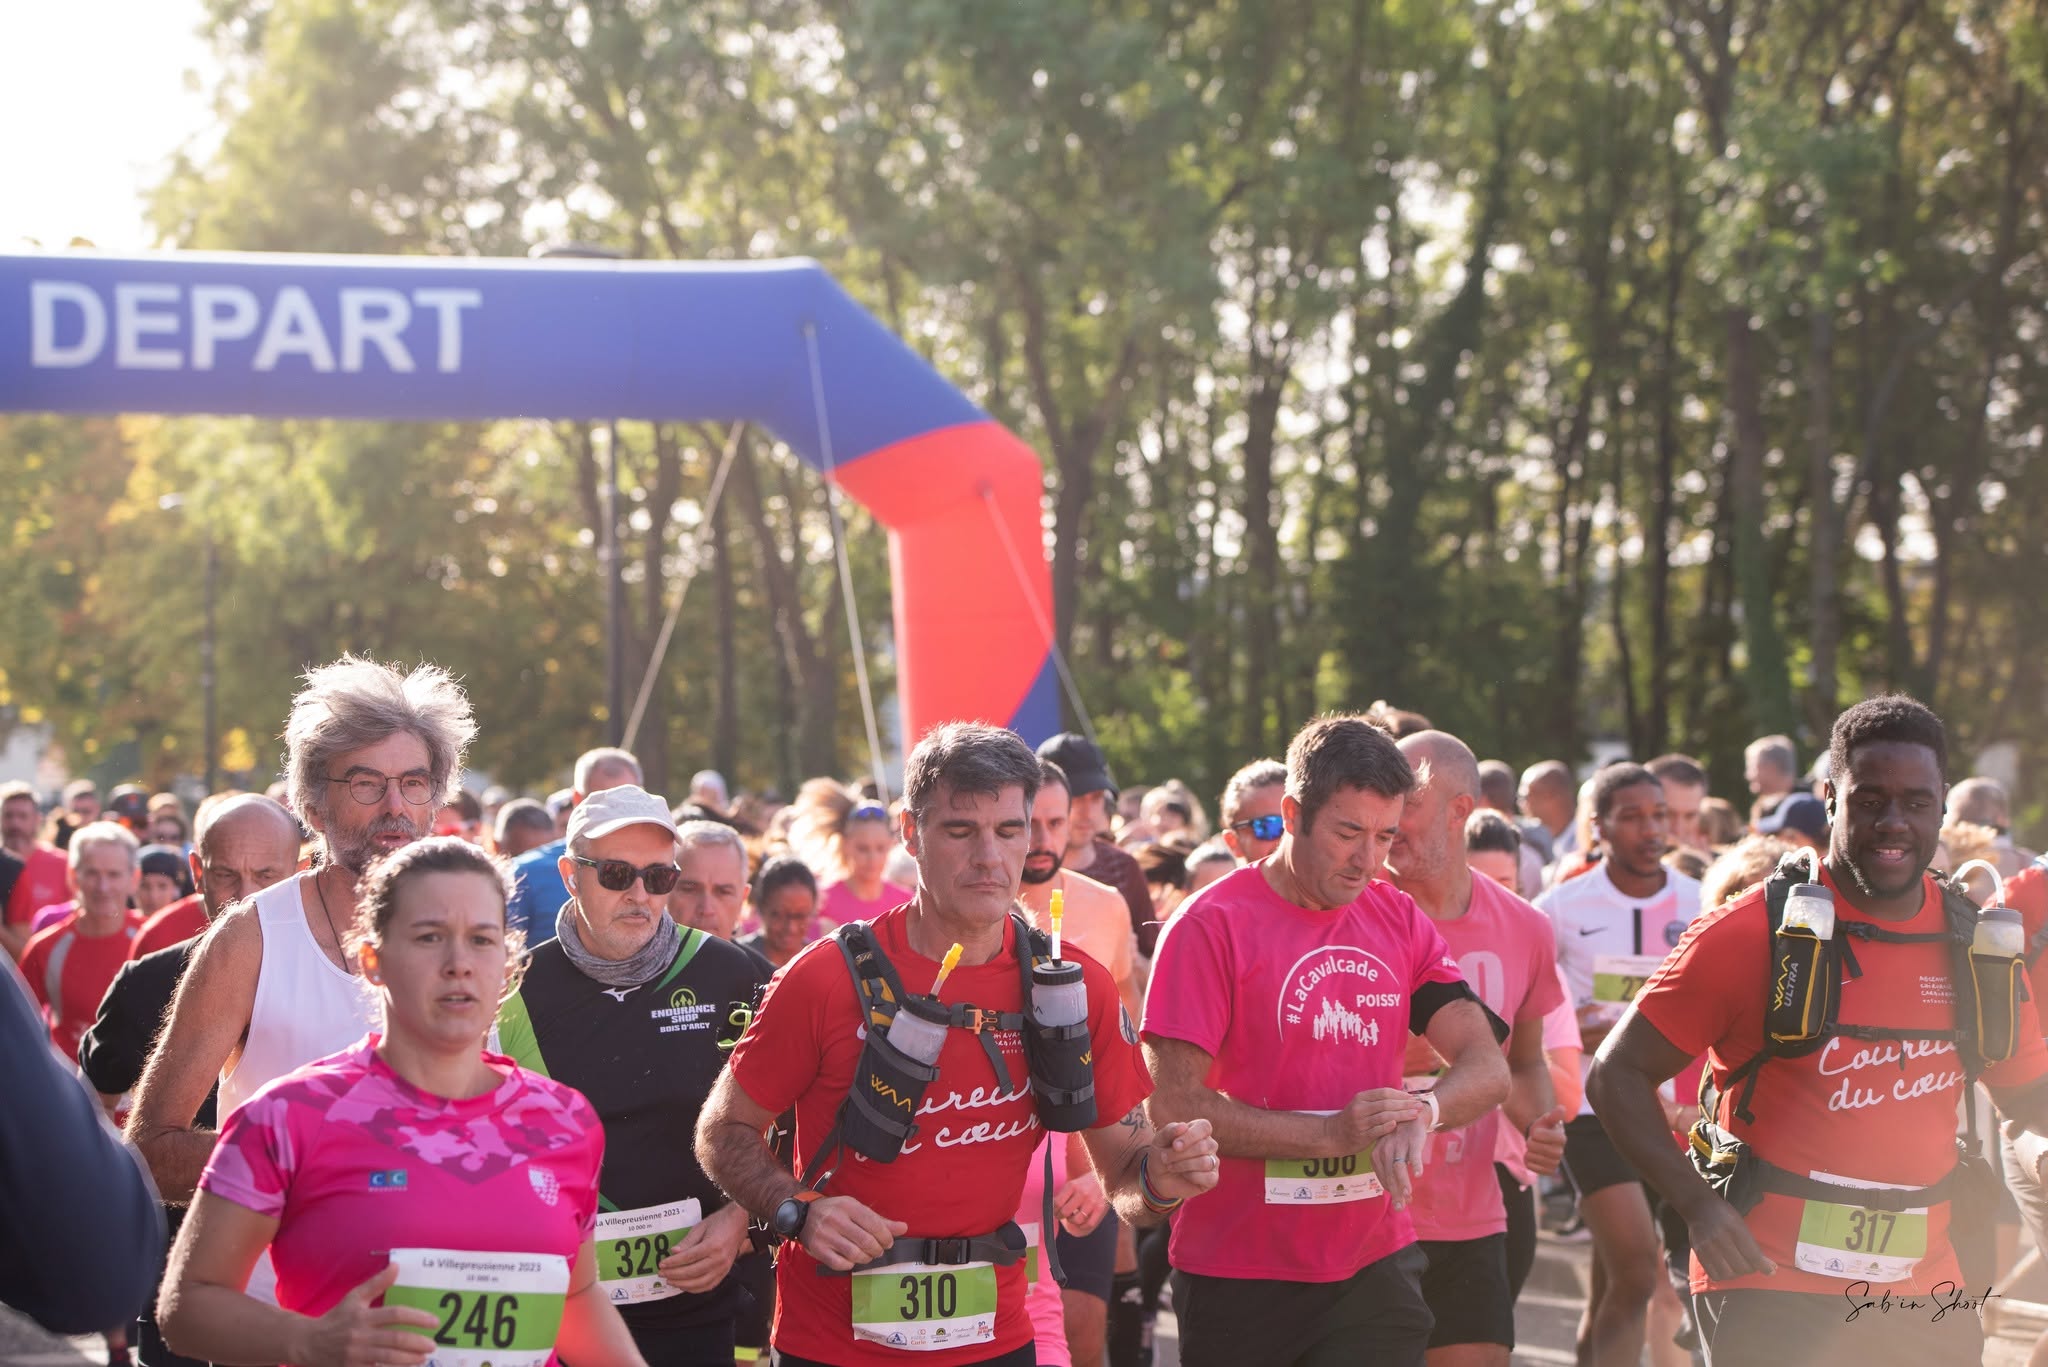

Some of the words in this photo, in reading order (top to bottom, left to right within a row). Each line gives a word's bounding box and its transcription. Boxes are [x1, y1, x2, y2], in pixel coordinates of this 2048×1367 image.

[30, 280, 483, 372] DEPART
[1286, 955, 1379, 1024] #LaCavalcade
[1356, 993, 1400, 1008] POISSY
[1784, 962, 1799, 1007] ULTRA
[651, 1004, 716, 1018] ENDURANCE
[660, 1025, 680, 1033] BOIS
[681, 1022, 710, 1031] D'ARCY
[671, 1013, 699, 1023] SHOP
[1828, 1077, 1885, 1111] du
[663, 1207, 680, 1218] 2023
[1845, 1211, 1897, 1254] 317
[614, 1233, 671, 1278] 328
[900, 1272, 957, 1320] 310
[434, 1291, 519, 1349] 246
